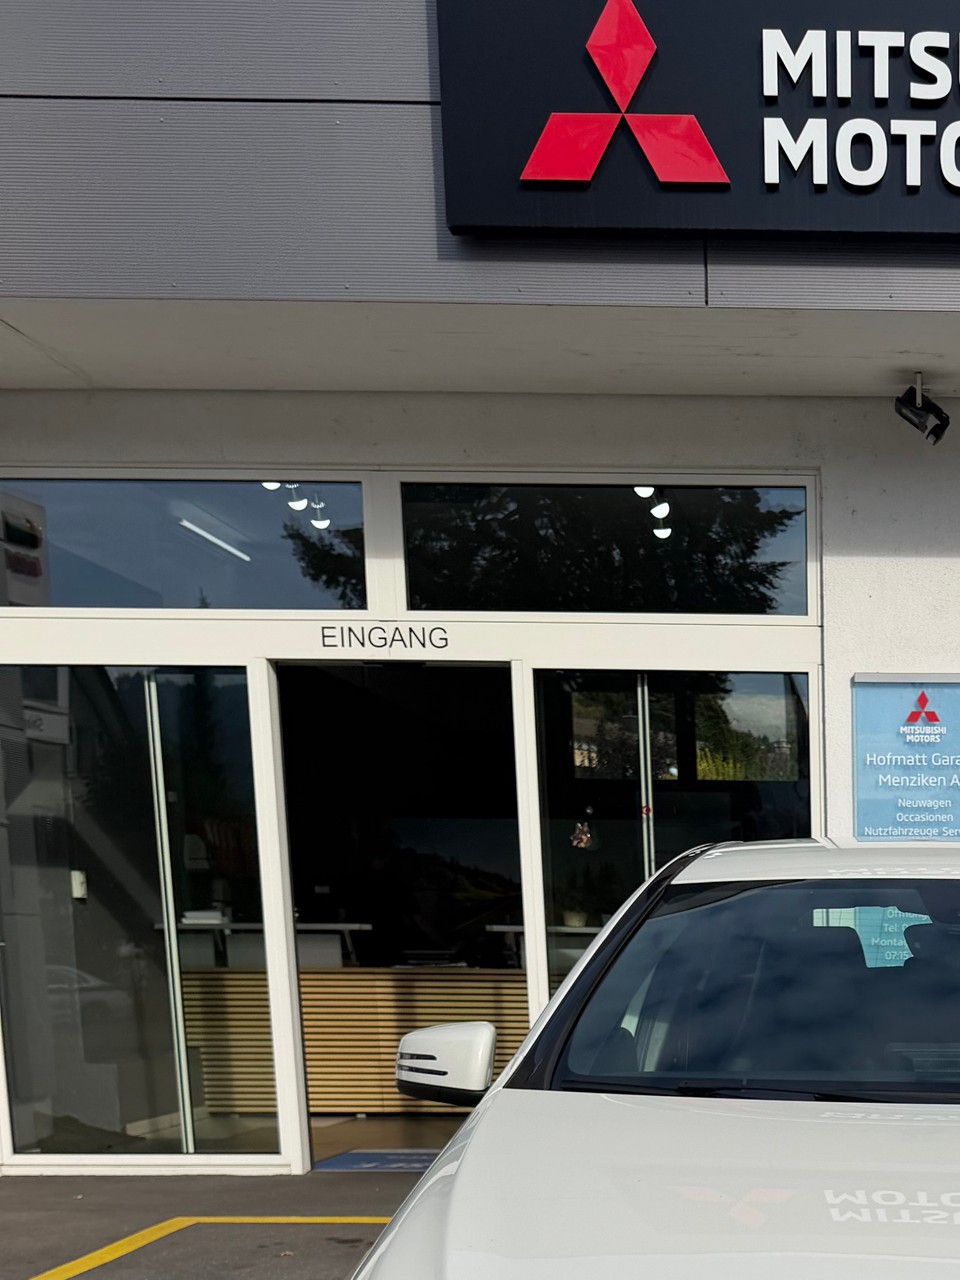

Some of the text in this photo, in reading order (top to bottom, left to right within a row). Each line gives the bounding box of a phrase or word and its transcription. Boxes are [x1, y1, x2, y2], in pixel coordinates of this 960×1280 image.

[321, 626, 449, 649] EINGANG
[900, 726, 947, 735] MITSUBISHI
[906, 734, 941, 743] MOTORS
[866, 752, 928, 767] Hofmatt
[878, 773, 947, 787] Menziken
[898, 798, 952, 810] Neuwagen
[896, 812, 954, 823] Occasionen
[864, 826, 939, 837] Nutzfahrzeuge
